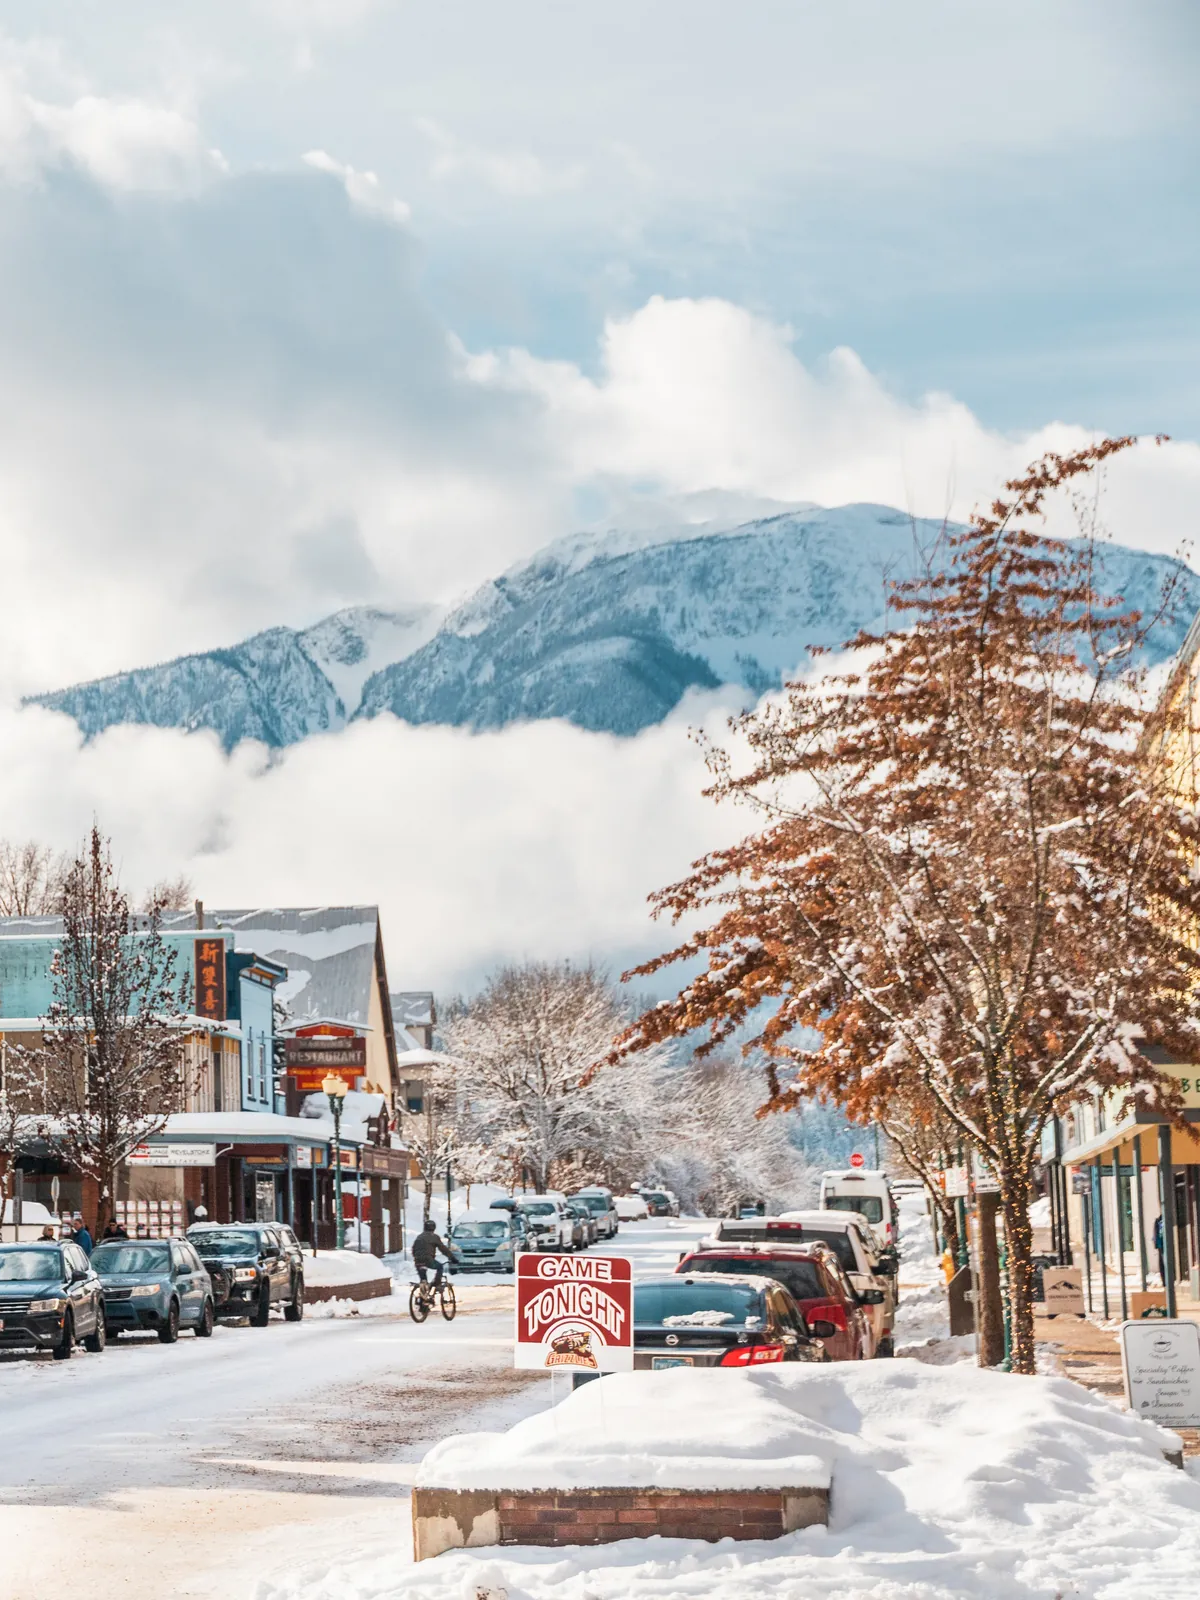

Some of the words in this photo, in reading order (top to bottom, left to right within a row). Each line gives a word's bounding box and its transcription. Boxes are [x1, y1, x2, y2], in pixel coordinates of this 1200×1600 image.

[288, 1051, 363, 1063] RESTAURANT
[538, 1257, 612, 1283] GAME
[524, 1282, 625, 1340] TONIGHT
[546, 1352, 597, 1367] GRIZZLIES
